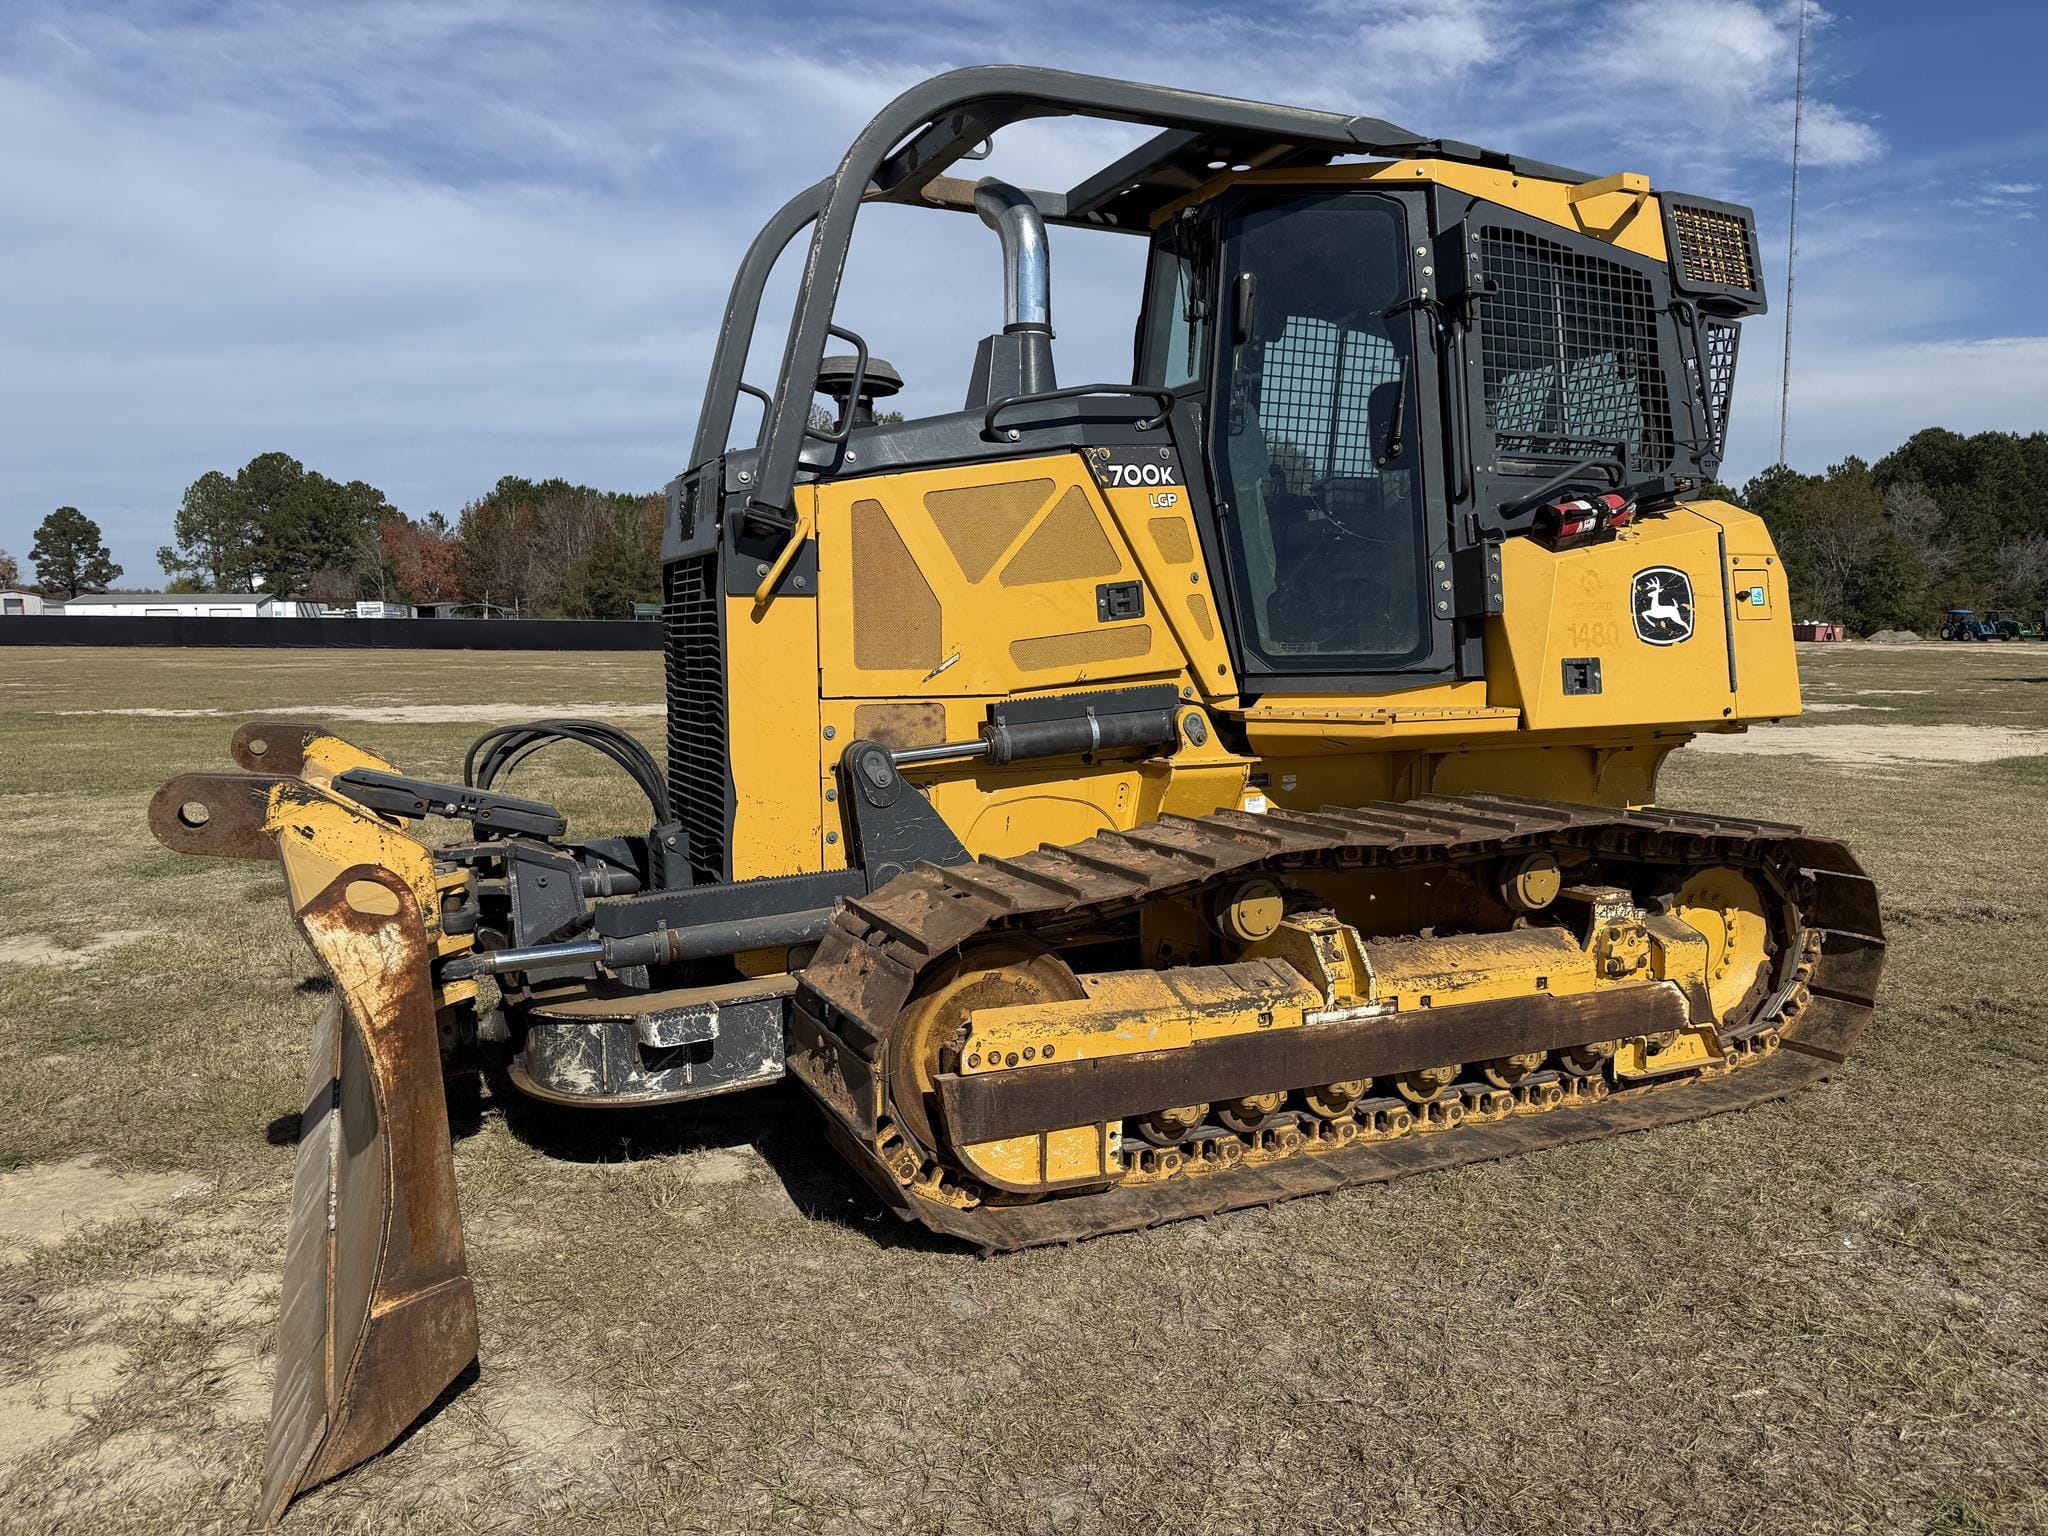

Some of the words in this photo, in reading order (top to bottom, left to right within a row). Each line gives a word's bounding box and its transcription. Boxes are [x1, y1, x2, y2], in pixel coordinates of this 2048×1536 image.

[1107, 464, 1176, 487] 700K
[1149, 493, 1177, 508] LGP
[1568, 621, 1620, 649] 1480
